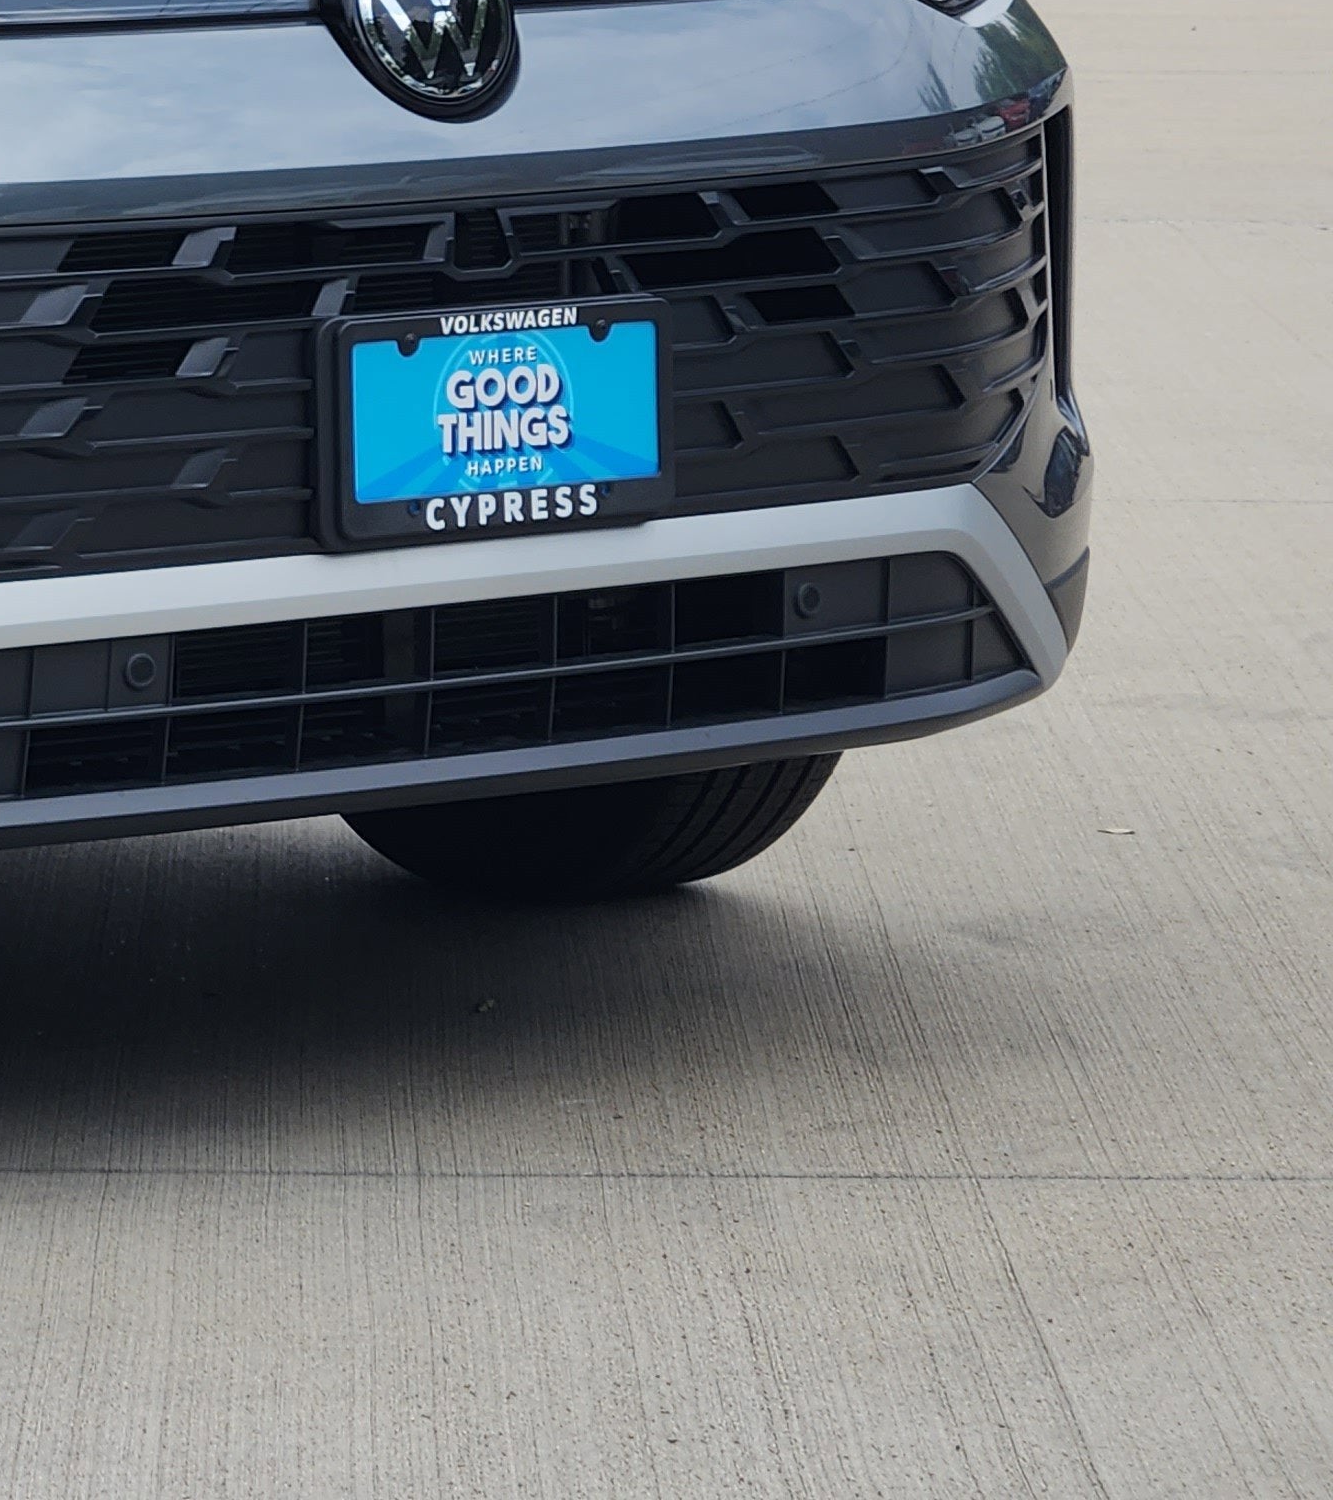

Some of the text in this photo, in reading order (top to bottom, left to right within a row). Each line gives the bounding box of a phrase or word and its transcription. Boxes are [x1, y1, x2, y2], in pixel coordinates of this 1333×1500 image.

[440, 307, 577, 335] VOLKSWAGEN
[469, 347, 537, 365] WHERE
[446, 364, 561, 409] GOOD
[437, 405, 571, 454] THINGS
[466, 457, 543, 476] HAPPEN
[425, 484, 599, 531] CYPRESS
